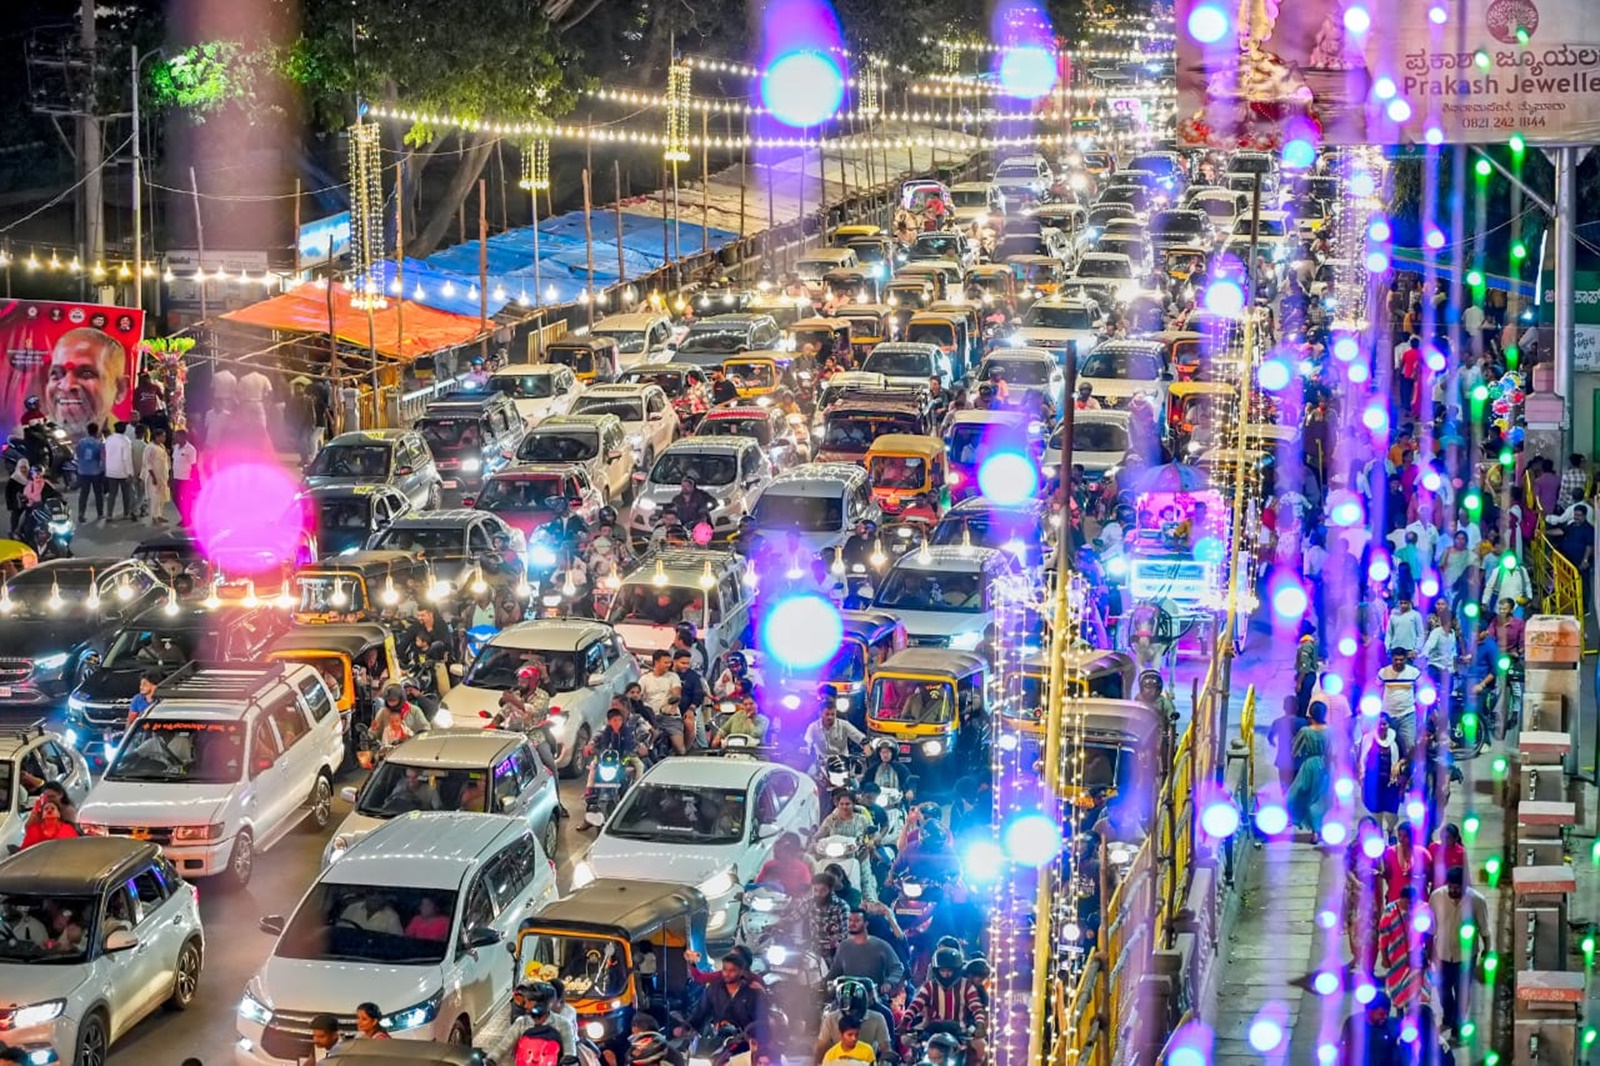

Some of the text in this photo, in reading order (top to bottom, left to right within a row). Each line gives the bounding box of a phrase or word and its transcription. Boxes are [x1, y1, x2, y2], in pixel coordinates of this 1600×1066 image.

[1496, 44, 1600, 76] ಜ್ಯೂಯಲ
[1404, 72, 1600, 95] Prakash Jewelle
[1462, 118, 1489, 128] 0821
[1493, 117, 1514, 127] 242
